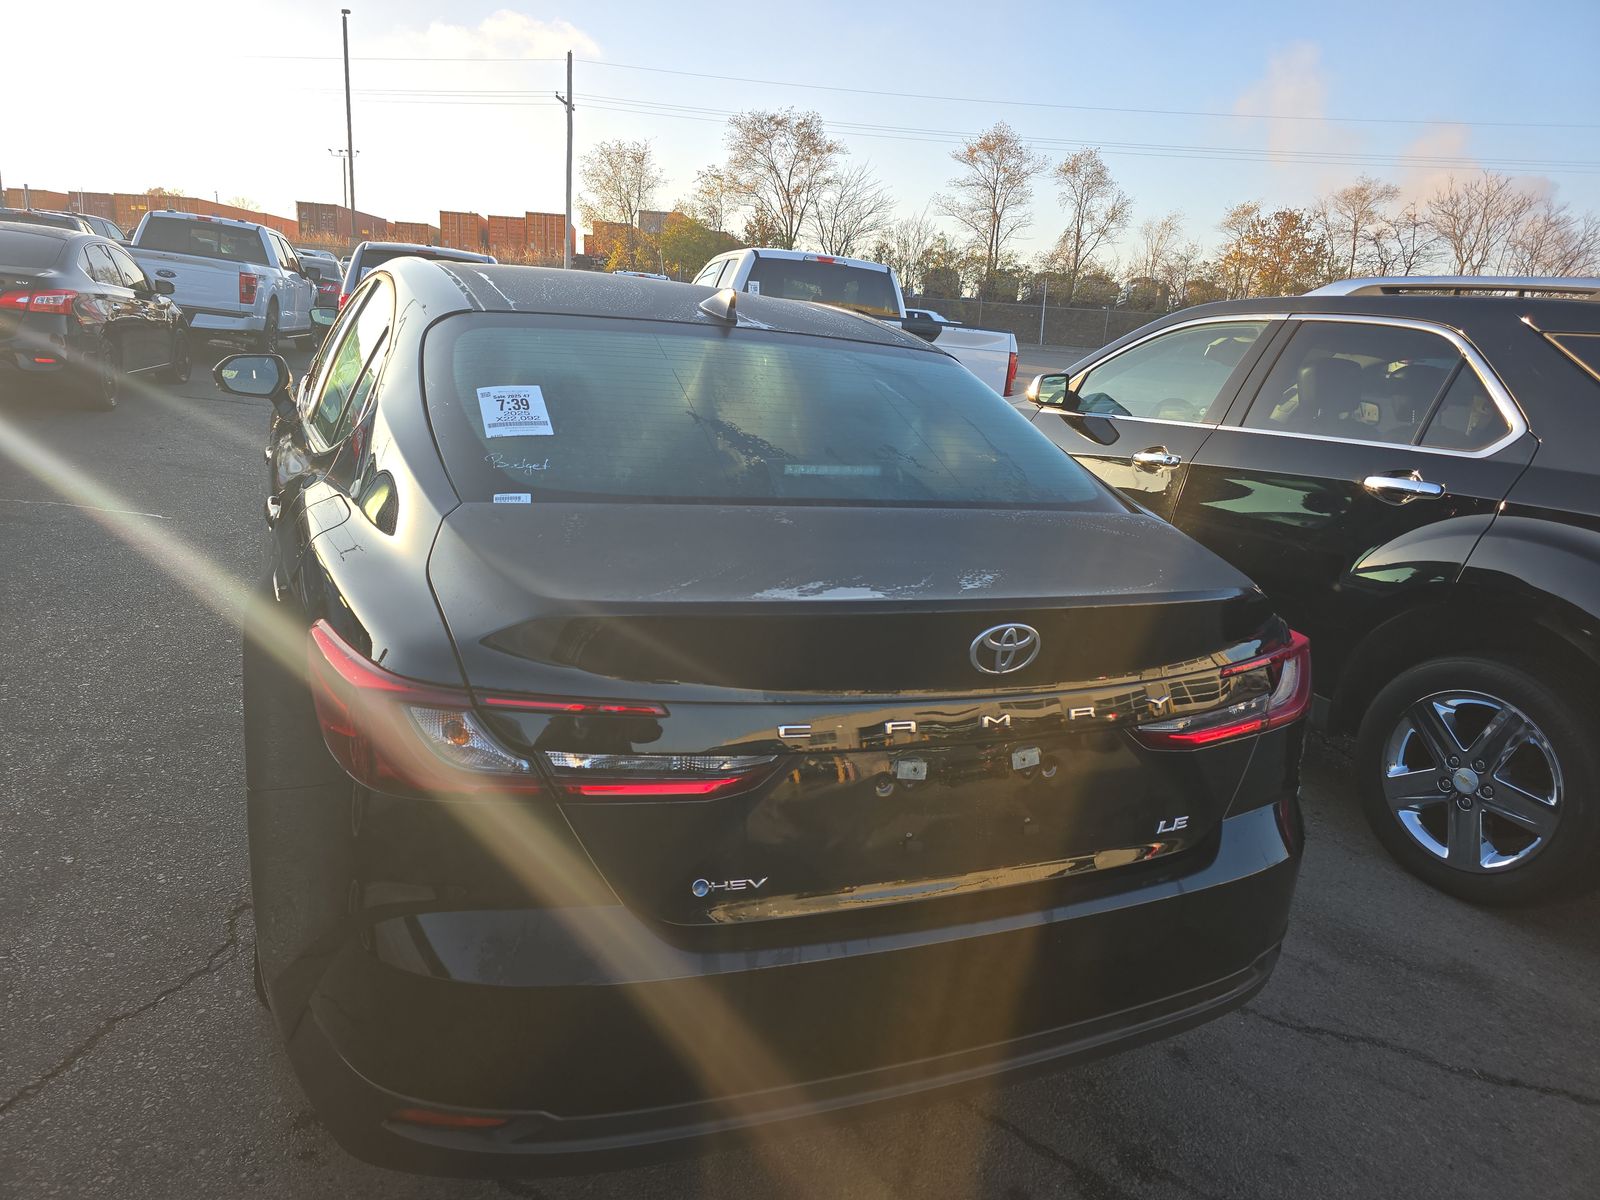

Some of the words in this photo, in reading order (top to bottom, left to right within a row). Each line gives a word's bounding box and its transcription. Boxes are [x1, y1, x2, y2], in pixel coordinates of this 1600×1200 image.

[496, 398, 530, 411] 7:39
[778, 696, 1170, 738] CAMRY
[1156, 815, 1190, 835] LE
[710, 876, 768, 892] HEV
